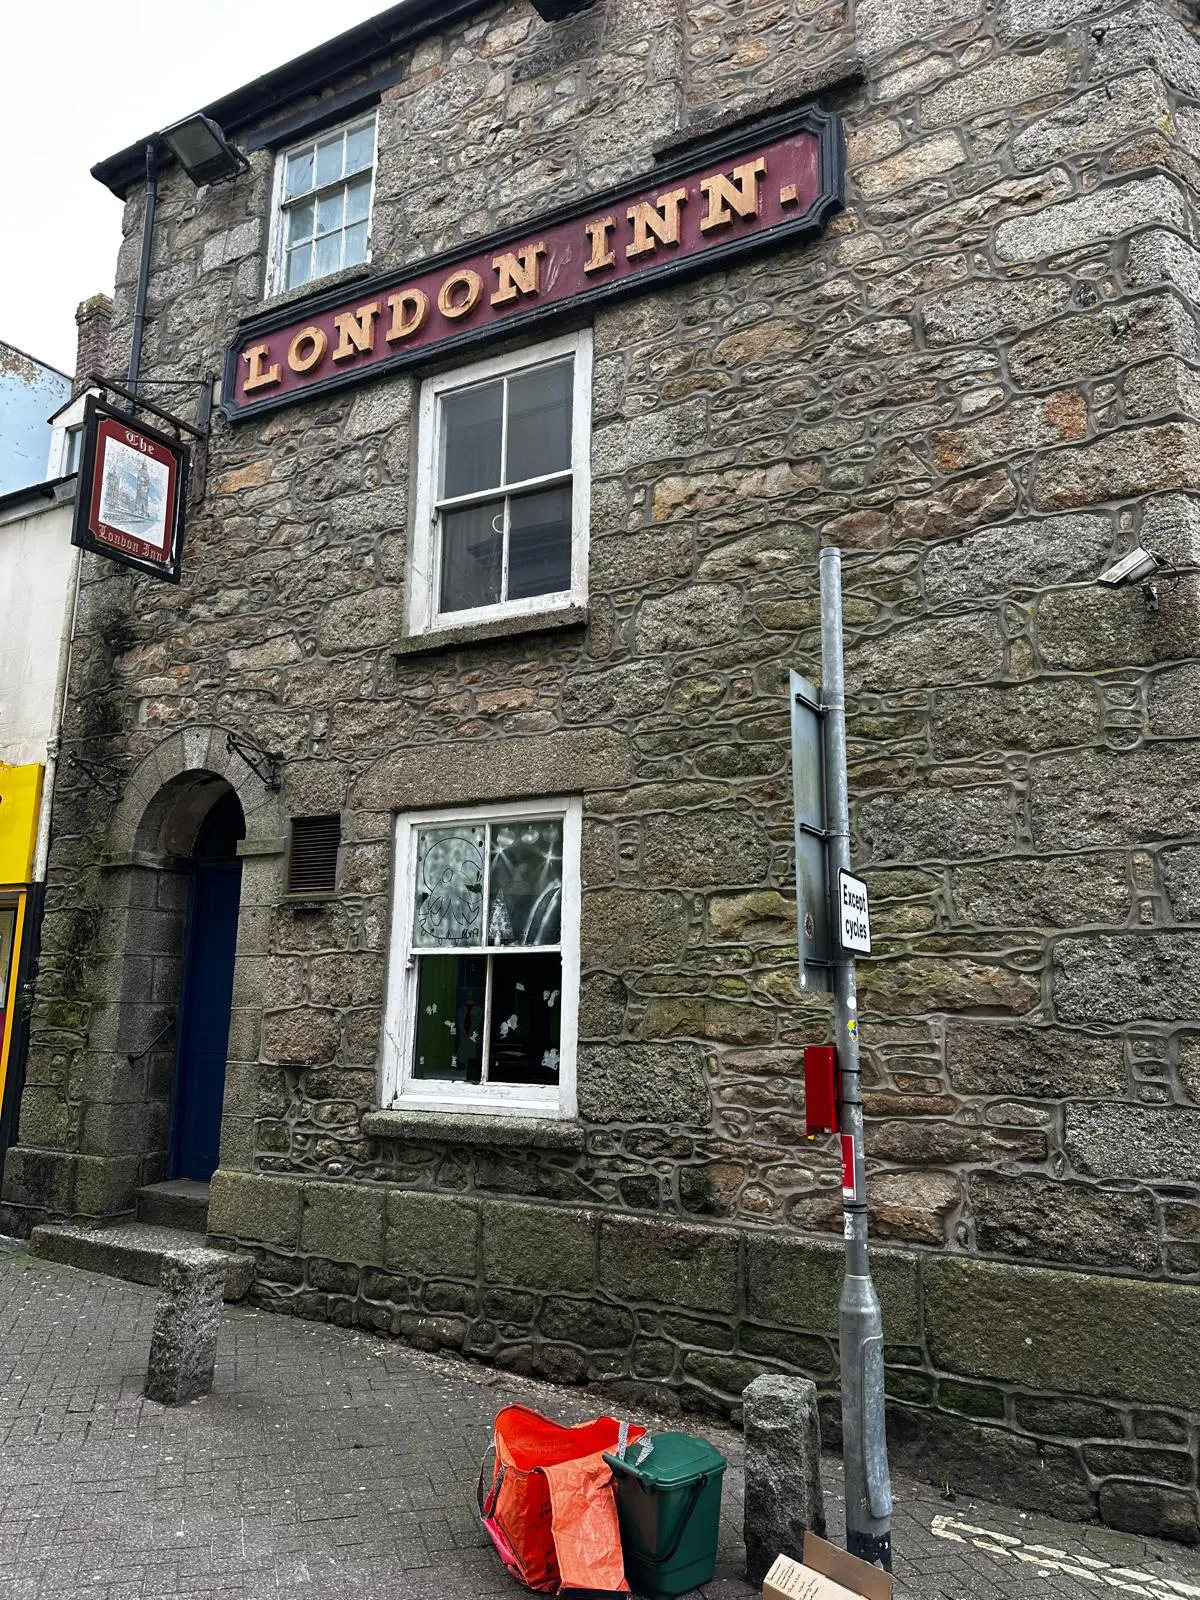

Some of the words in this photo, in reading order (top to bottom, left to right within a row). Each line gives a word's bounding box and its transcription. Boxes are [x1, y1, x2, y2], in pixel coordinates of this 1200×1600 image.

[242, 241, 547, 394] LONDON
[583, 156, 798, 276] INN.
[125, 430, 155, 455] The
[98, 523, 139, 553] London
[142, 541, 163, 563] Inn
[843, 884, 866, 913] Except
[845, 917, 867, 940] cycles
